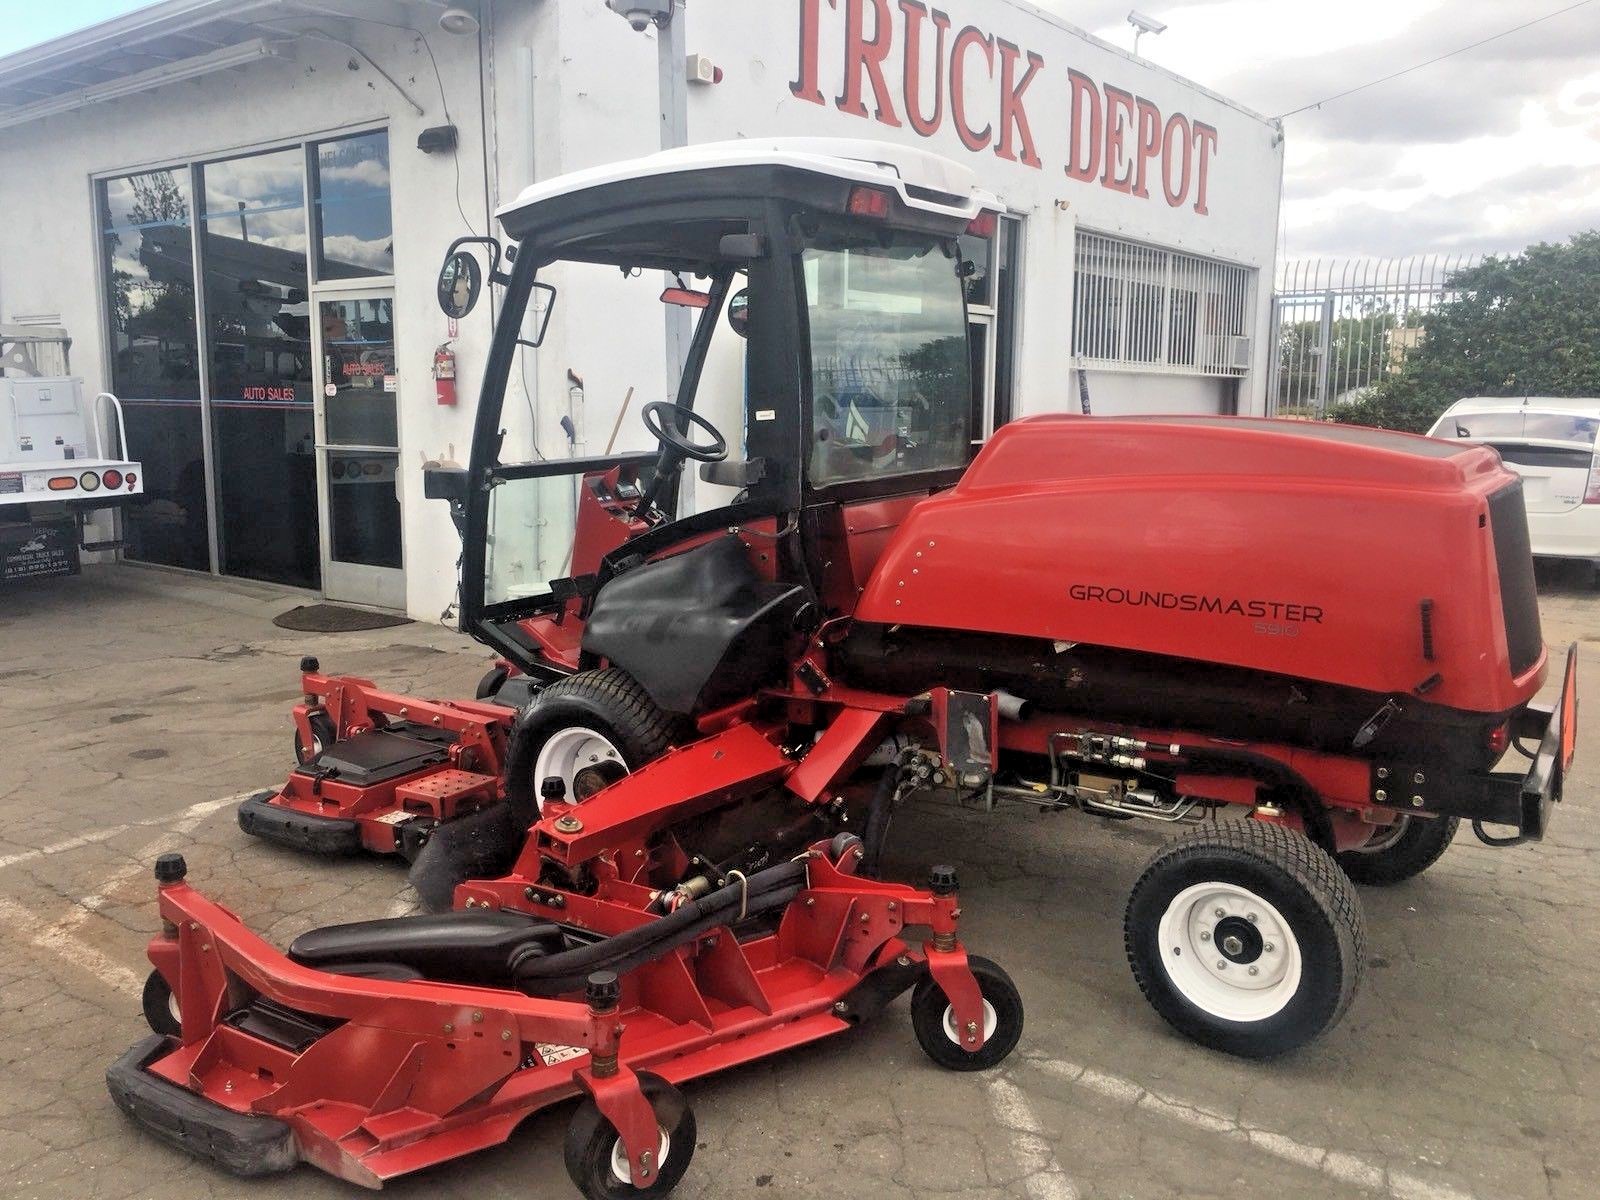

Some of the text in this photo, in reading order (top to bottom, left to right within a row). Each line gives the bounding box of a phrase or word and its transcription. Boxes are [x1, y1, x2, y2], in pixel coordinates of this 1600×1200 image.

[789, 0, 1218, 216] TRUCK DEPOT
[343, 363, 361, 376] AUTO
[243, 387, 294, 401] AUTO SALES
[1069, 585, 1324, 623] GROUNDSMASTER
